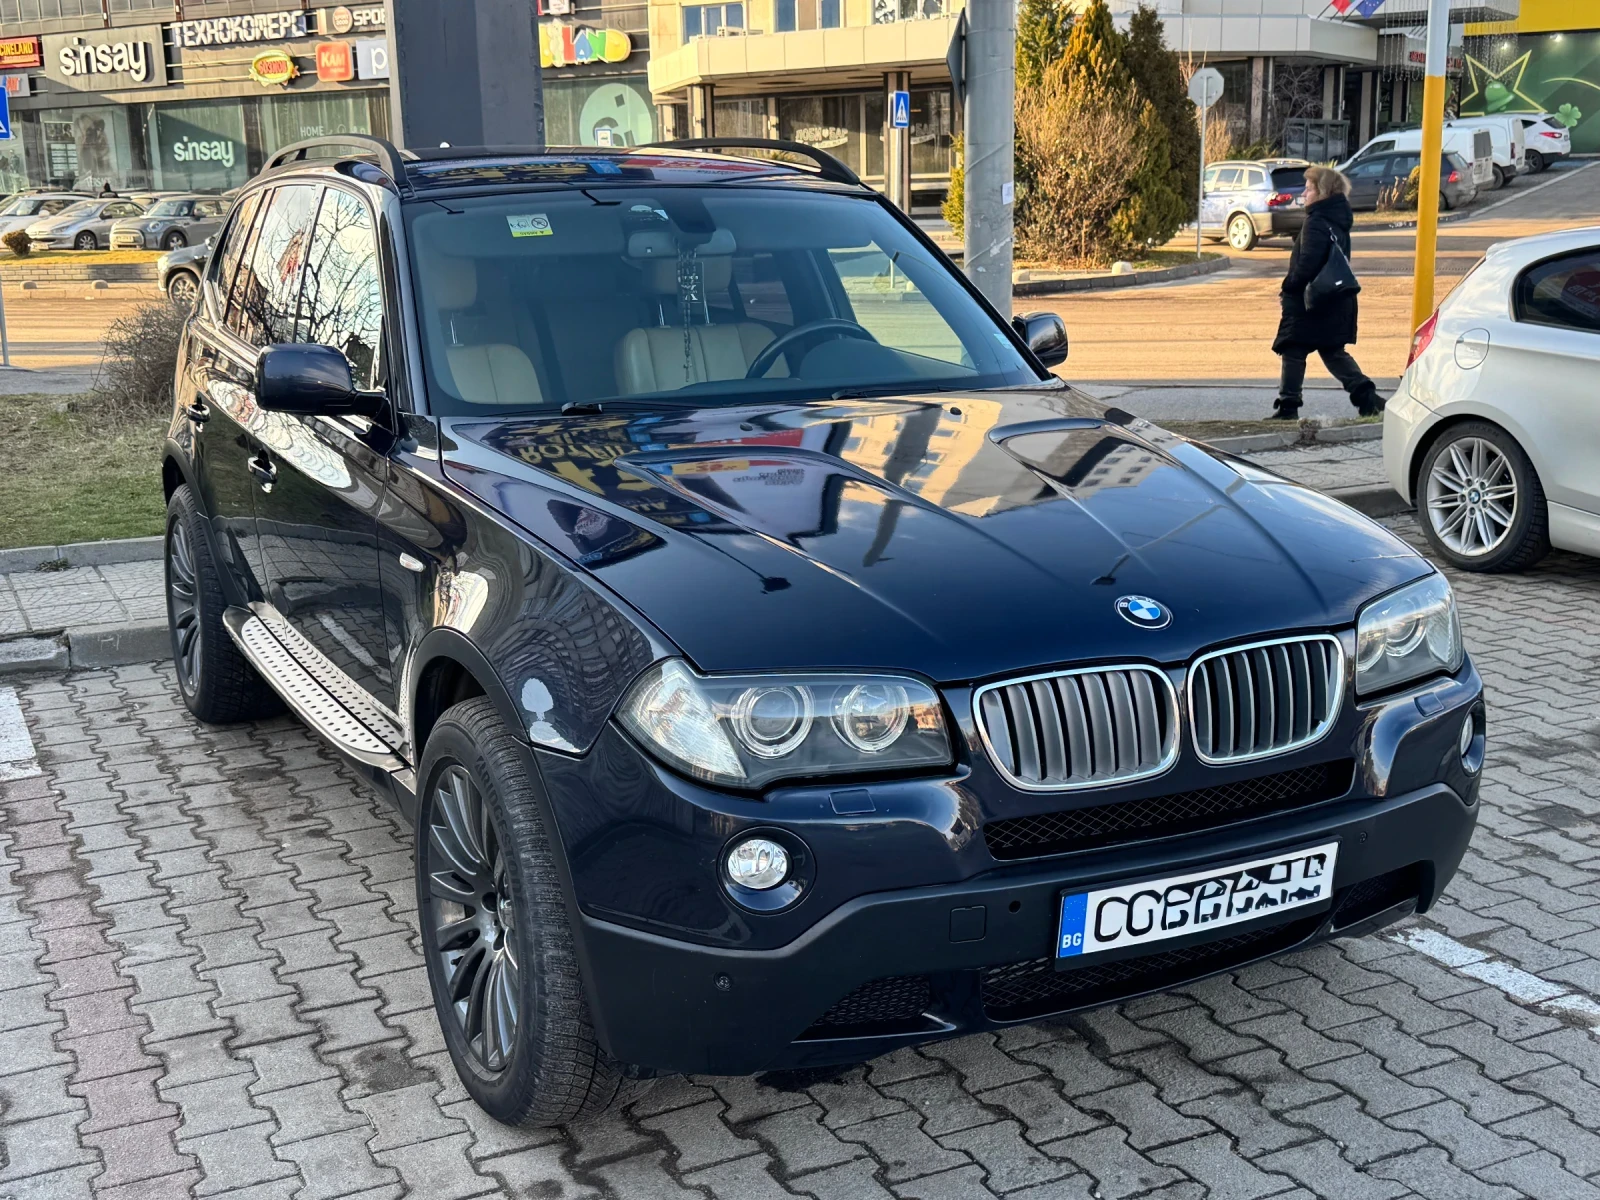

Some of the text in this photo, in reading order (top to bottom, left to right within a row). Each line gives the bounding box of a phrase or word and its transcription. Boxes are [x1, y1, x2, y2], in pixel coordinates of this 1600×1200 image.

[0, 41, 34, 57] CINELAND
[59, 36, 147, 82] sinsay
[300, 126, 324, 137] HOME
[174, 136, 234, 168] sinsay
[1062, 932, 1082, 949] BG
